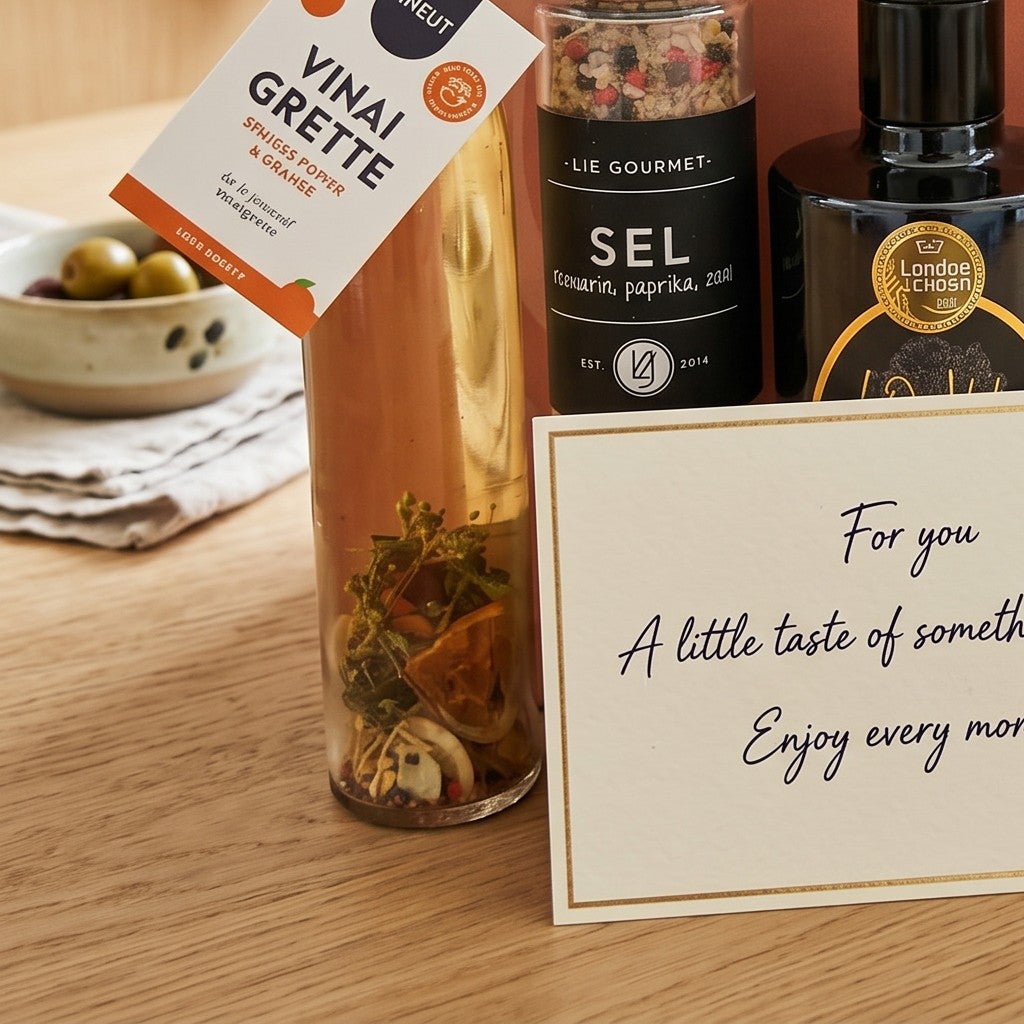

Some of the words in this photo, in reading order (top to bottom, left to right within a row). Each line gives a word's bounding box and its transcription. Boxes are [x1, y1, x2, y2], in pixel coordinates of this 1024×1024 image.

[301, 44, 405, 141] VINAI
[248, 70, 395, 191] GRETTE
[609, 154, 706, 175] GOURMET
[590, 226, 690, 268] SEL
[901, 258, 971, 277] Londoe
[626, 274, 698, 302] paprika,
[581, 358, 605, 371] EST.
[680, 355, 709, 369] 2014
[840, 501, 905, 564] For
[910, 523, 980, 578] you
[618, 614, 664, 678] A
[675, 613, 764, 663] little
[774, 609, 858, 657] taste
[867, 605, 903, 667] of
[742, 706, 851, 786] Enjoy
[866, 722, 951, 774] every
